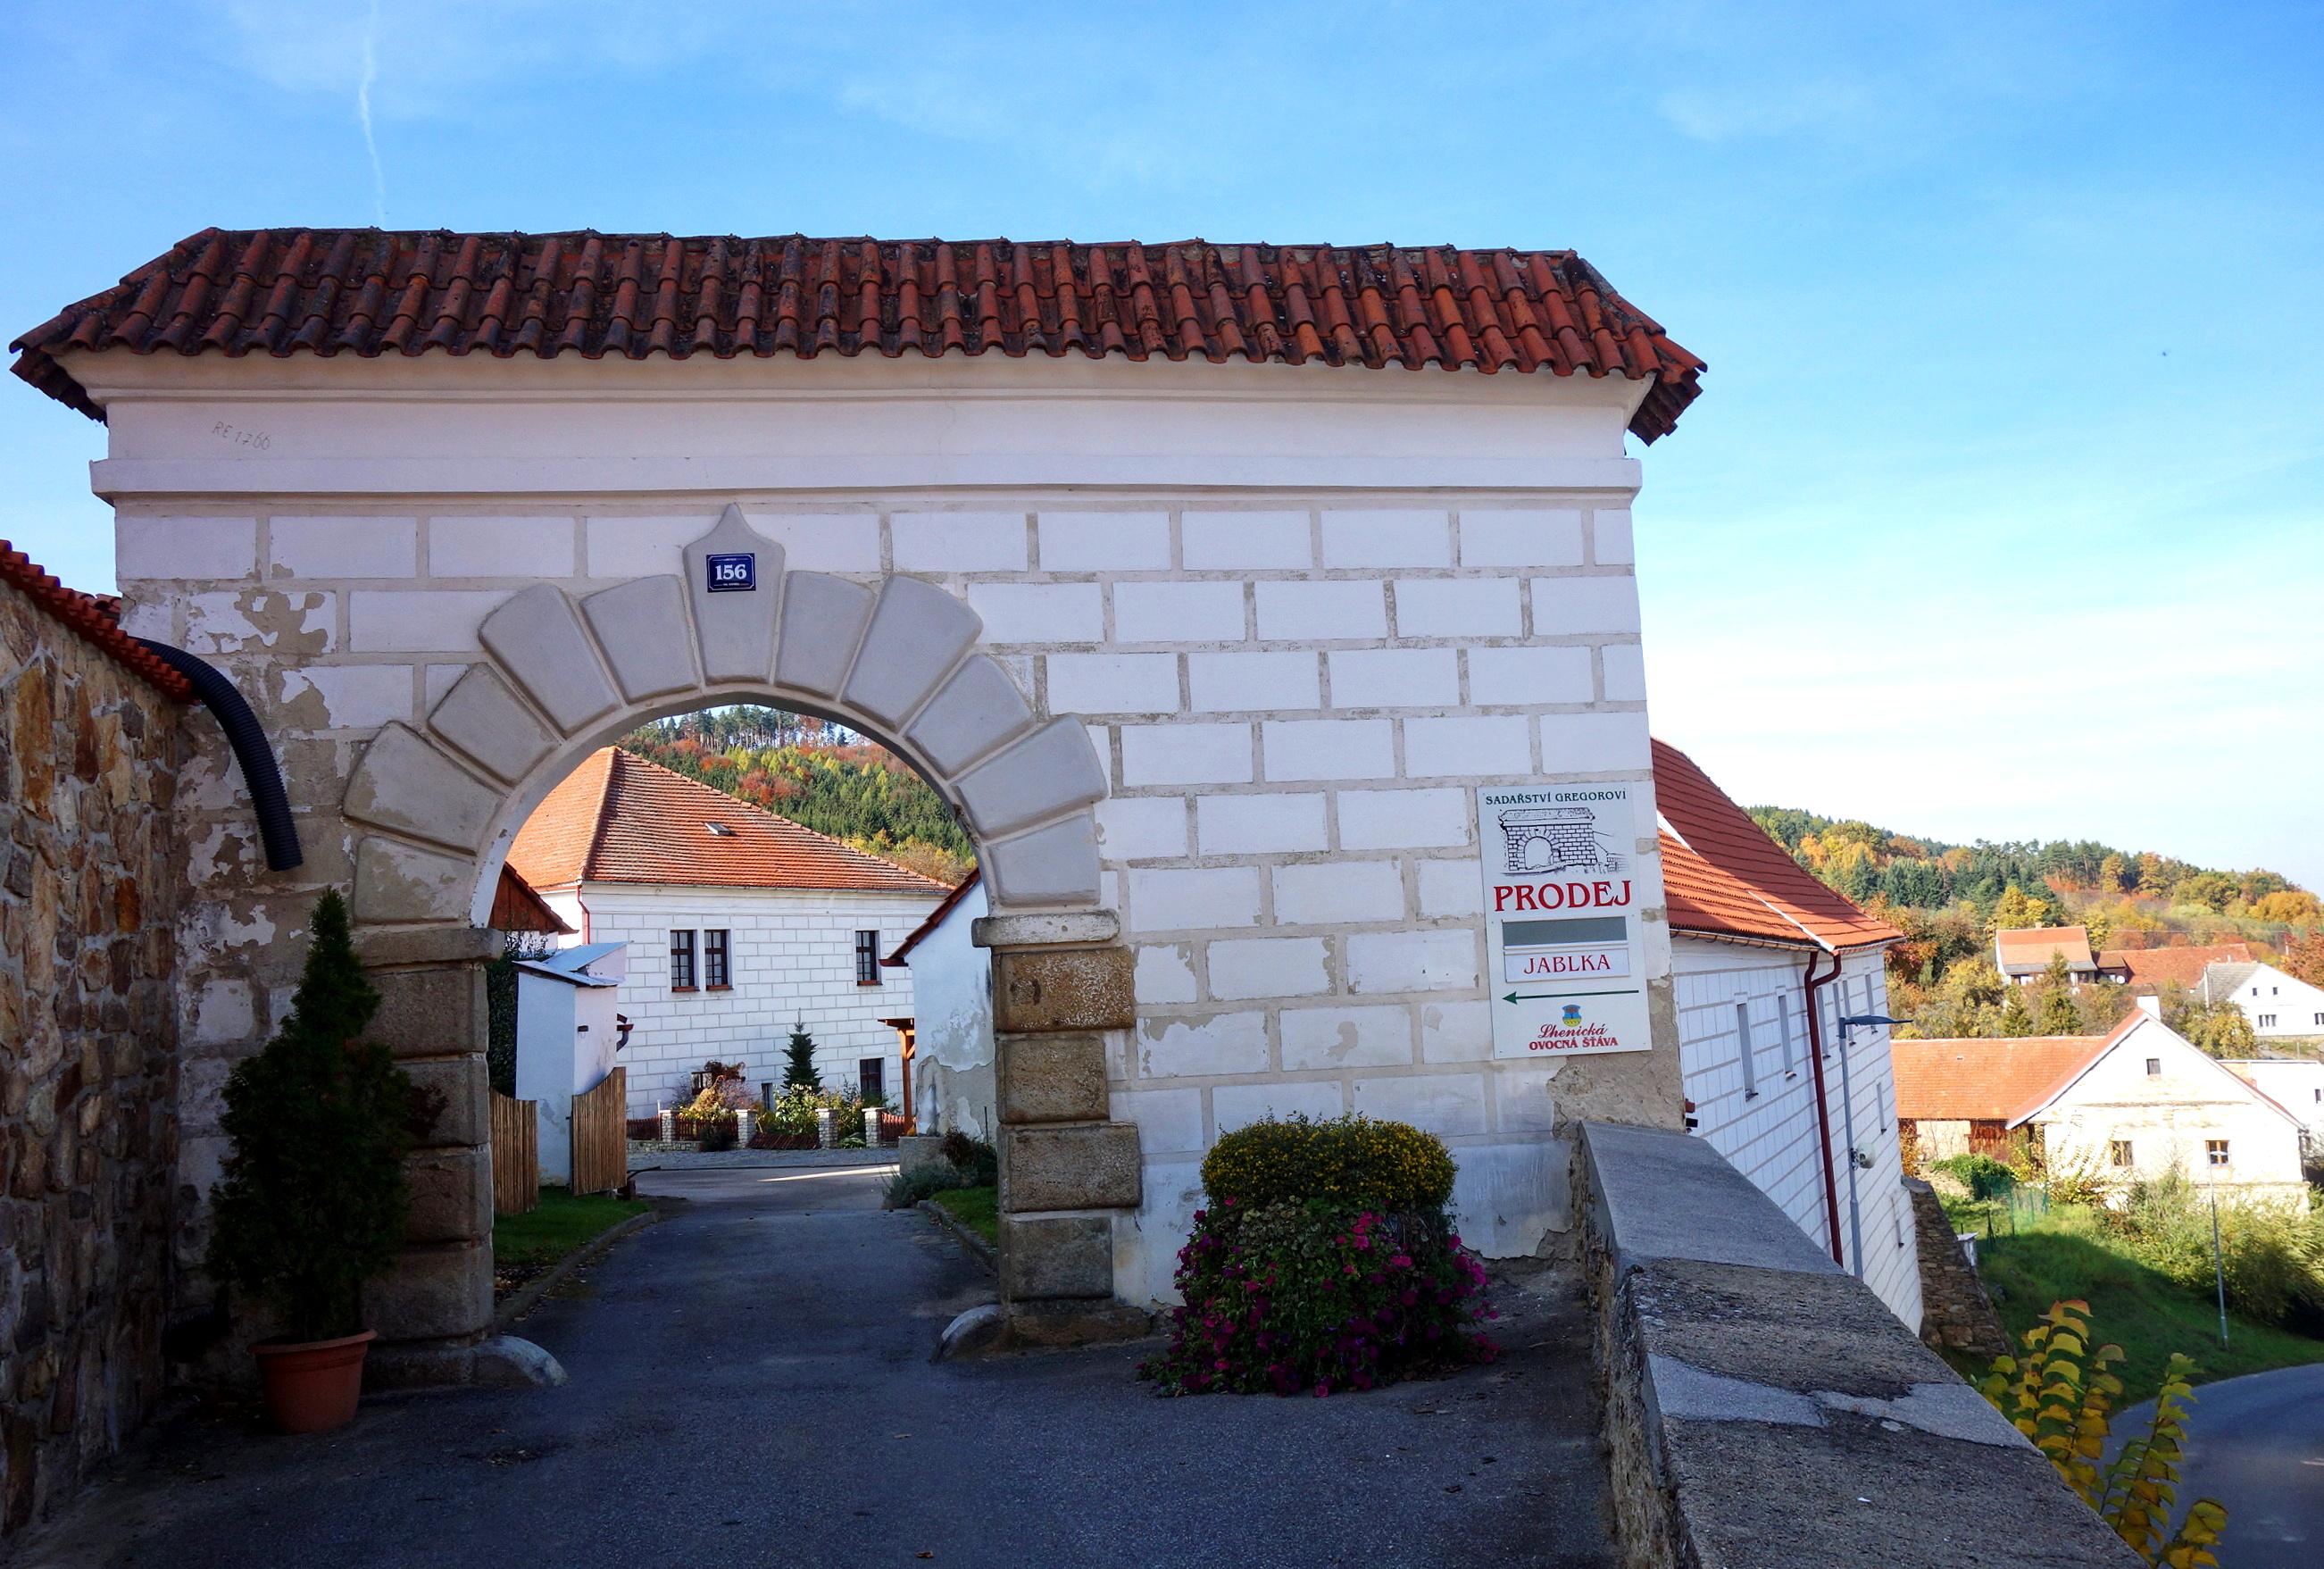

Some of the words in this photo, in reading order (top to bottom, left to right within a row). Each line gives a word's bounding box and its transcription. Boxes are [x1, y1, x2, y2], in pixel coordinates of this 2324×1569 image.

[715, 563, 747, 580] 156
[1486, 791, 1551, 805] SADAŘSTVÍ
[1555, 790, 1627, 802] GREGOROVI
[1494, 880, 1631, 912] PRODEJ
[1524, 954, 1611, 974] JABLKA
[1537, 1022, 1608, 1039] Lhenická
[1529, 1038, 1578, 1050] OVOCNÁ
[1582, 1035, 1619, 1047] ŠŤÁVA
